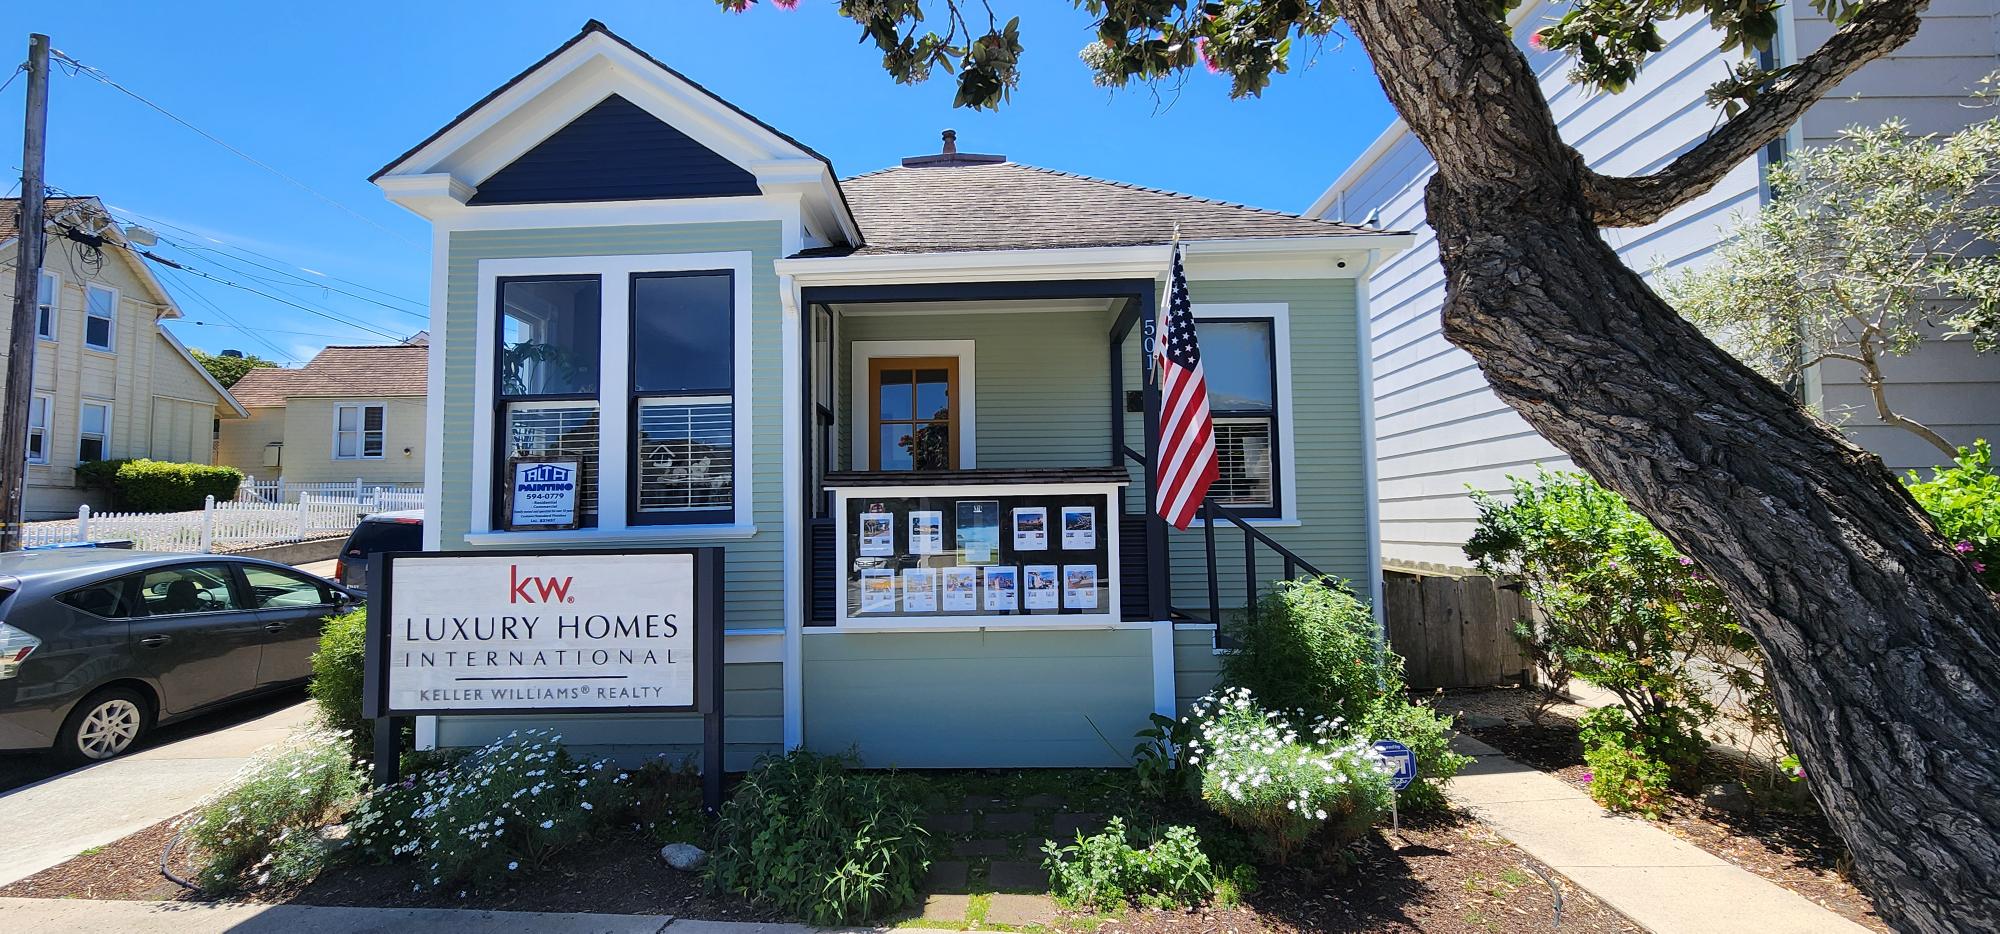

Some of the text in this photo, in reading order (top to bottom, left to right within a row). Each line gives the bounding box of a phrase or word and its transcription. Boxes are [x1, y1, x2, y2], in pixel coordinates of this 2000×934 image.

[1144, 319, 1155, 370] 501
[526, 466, 568, 481] ALTA
[517, 483, 574, 491] PAINTING
[406, 614, 678, 641] LUXURY HOMES
[405, 649, 677, 667] INTERNATIONAL
[420, 689, 482, 701] KELLER
[597, 687, 663, 699] REALTY
